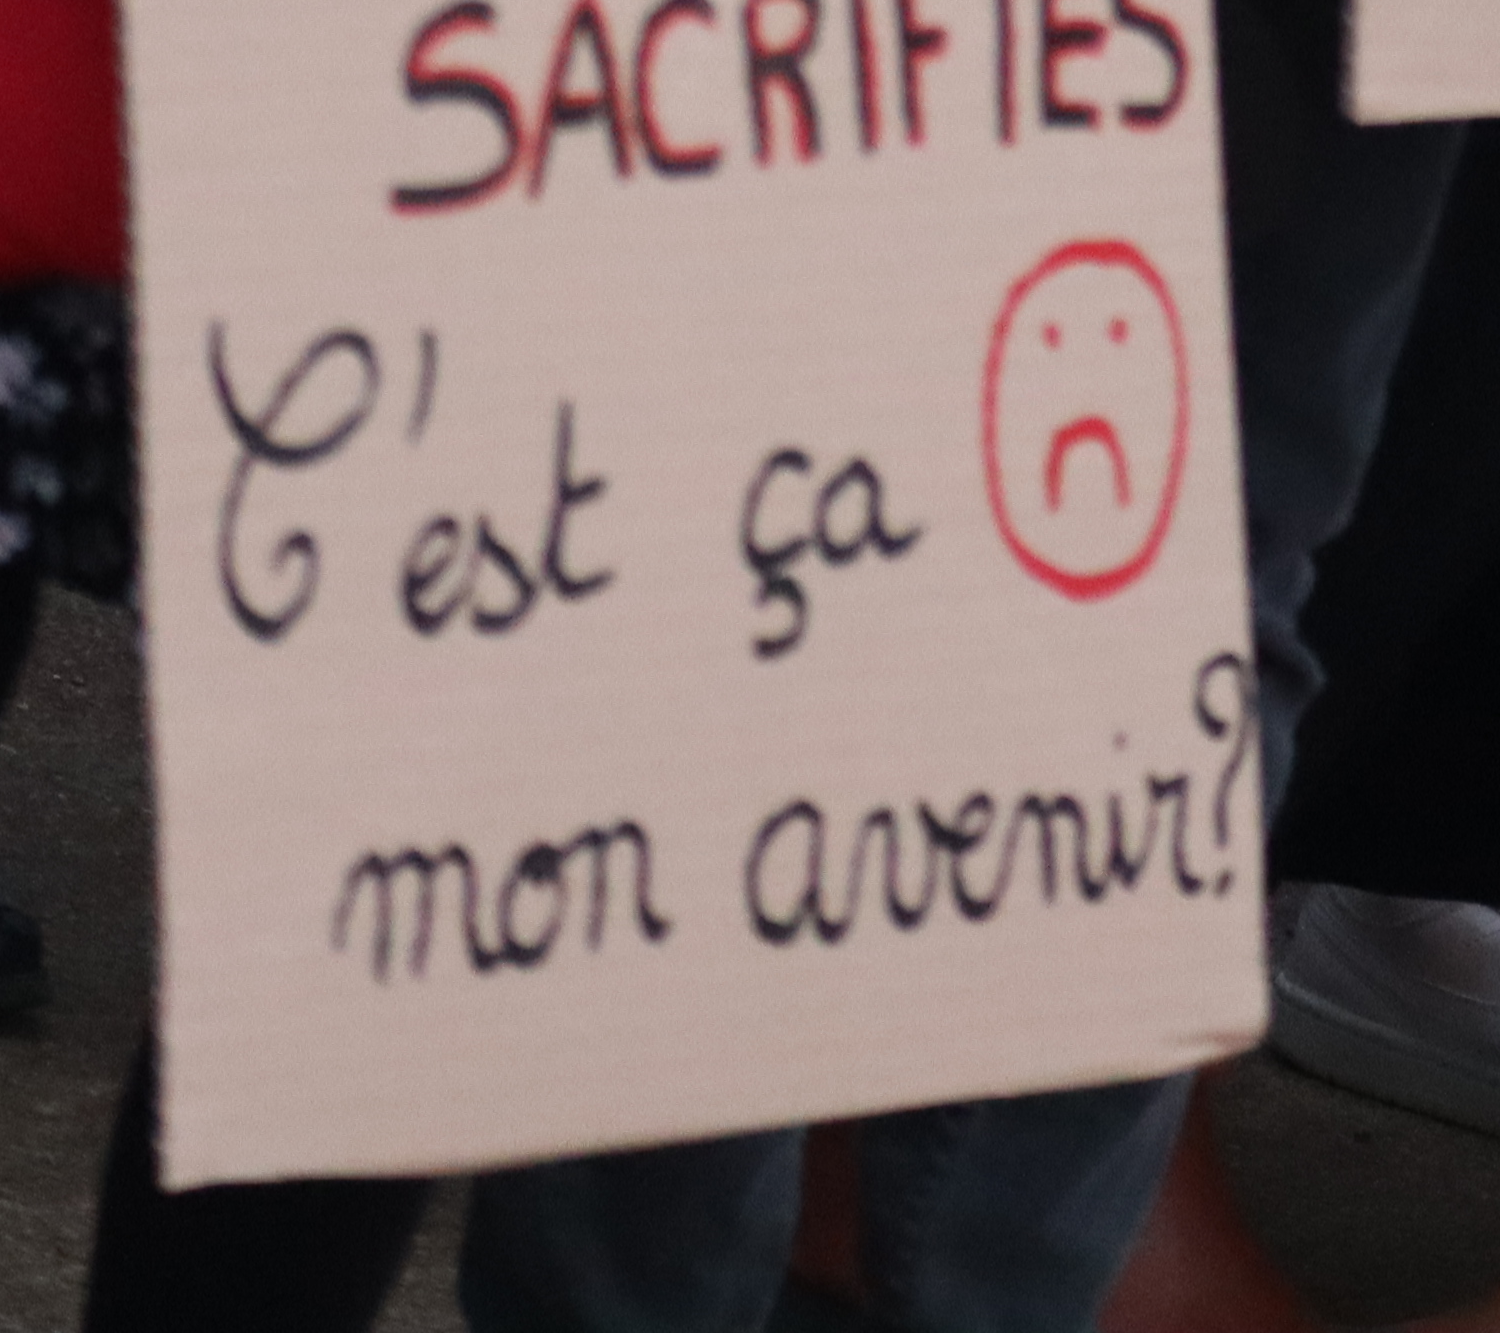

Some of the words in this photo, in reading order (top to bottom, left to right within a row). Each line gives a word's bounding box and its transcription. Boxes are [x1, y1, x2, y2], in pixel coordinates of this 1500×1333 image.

[207, 319, 611, 642] C'est
[741, 444, 921, 658] ça
[332, 813, 670, 986] mon
[743, 653, 1257, 947] avenir?
